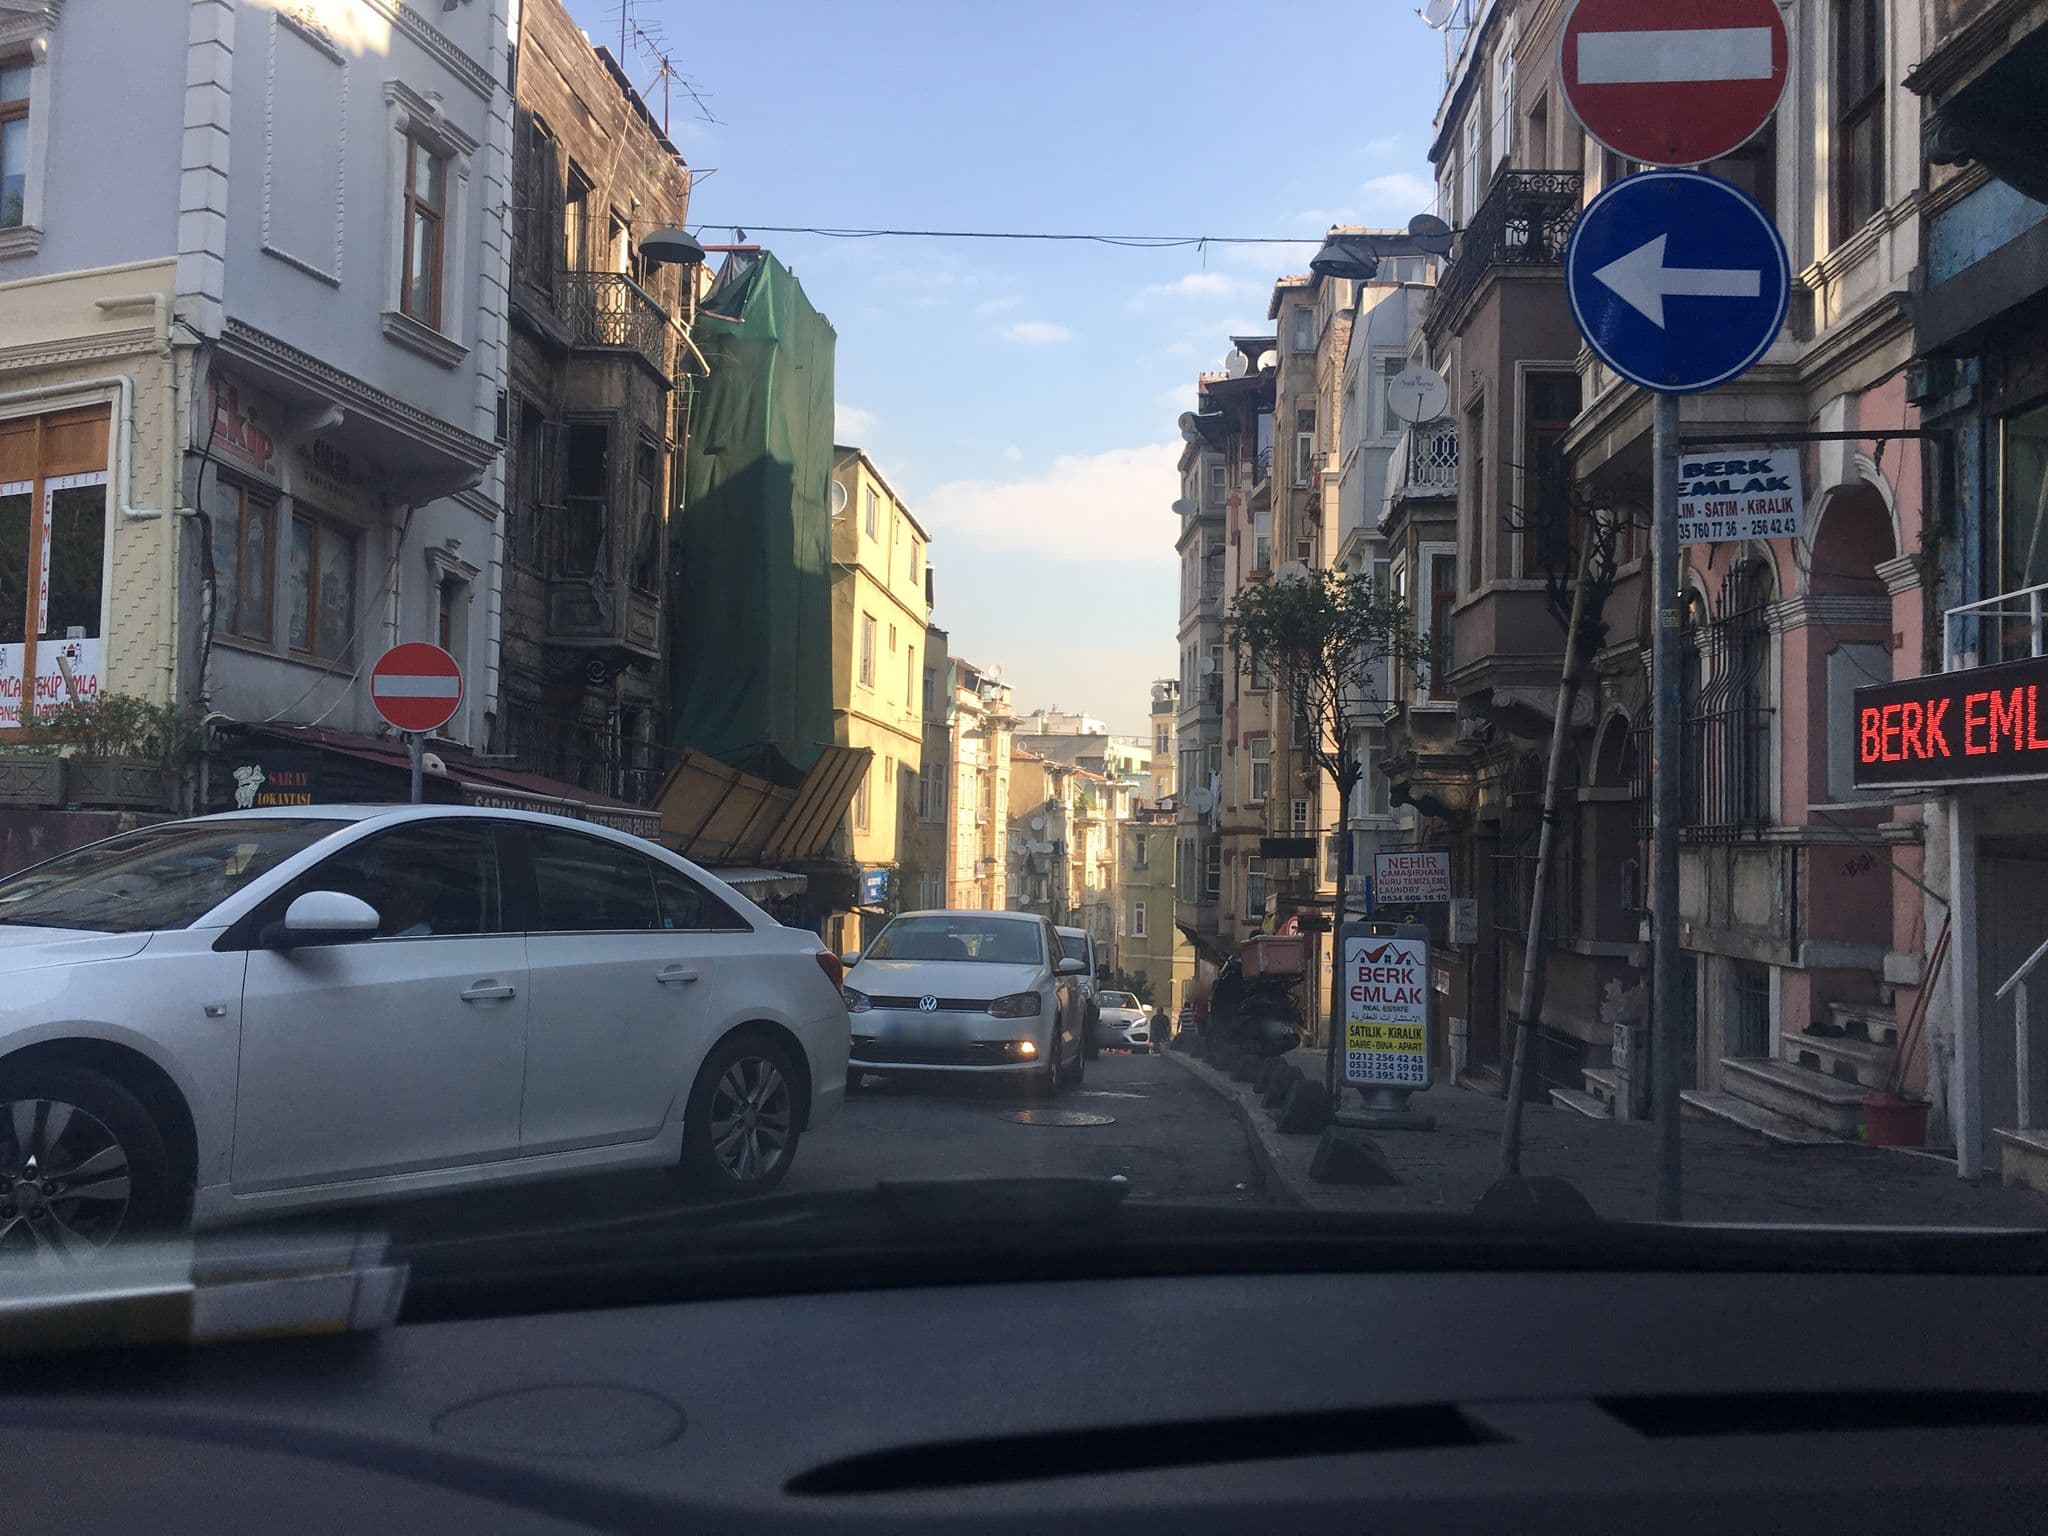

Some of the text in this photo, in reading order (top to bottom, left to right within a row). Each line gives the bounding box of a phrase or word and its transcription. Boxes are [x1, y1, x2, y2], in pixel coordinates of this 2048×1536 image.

[1683, 458, 1775, 479] BERK
[1678, 503, 1695, 519] IM
[1705, 501, 1738, 517] SATIM
[1693, 522, 1709, 538] 760
[1711, 521, 1722, 537] 77
[1725, 520, 1737, 536] 36
[1751, 519, 1768, 535] 256
[1770, 518, 1782, 534] 42
[1784, 517, 1797, 533] 43
[1860, 685, 2048, 763] BERK EML
[1379, 878, 1402, 886] KURU
[1379, 886, 1420, 894] LAUNDRY
[1358, 966, 1414, 984] BERK
[1350, 985, 1423, 1004] EMLAK
[1362, 1004, 1409, 1013] REAL ESTATE
[1350, 1024, 1382, 1038] SATILIK
[1398, 1042, 1423, 1052] APART
[1350, 1052, 1424, 1064] 0212 256 42 43
[1350, 1061, 1424, 1072] 0532 254 59 08
[1349, 1069, 1424, 1082] 0535 395 42 53
